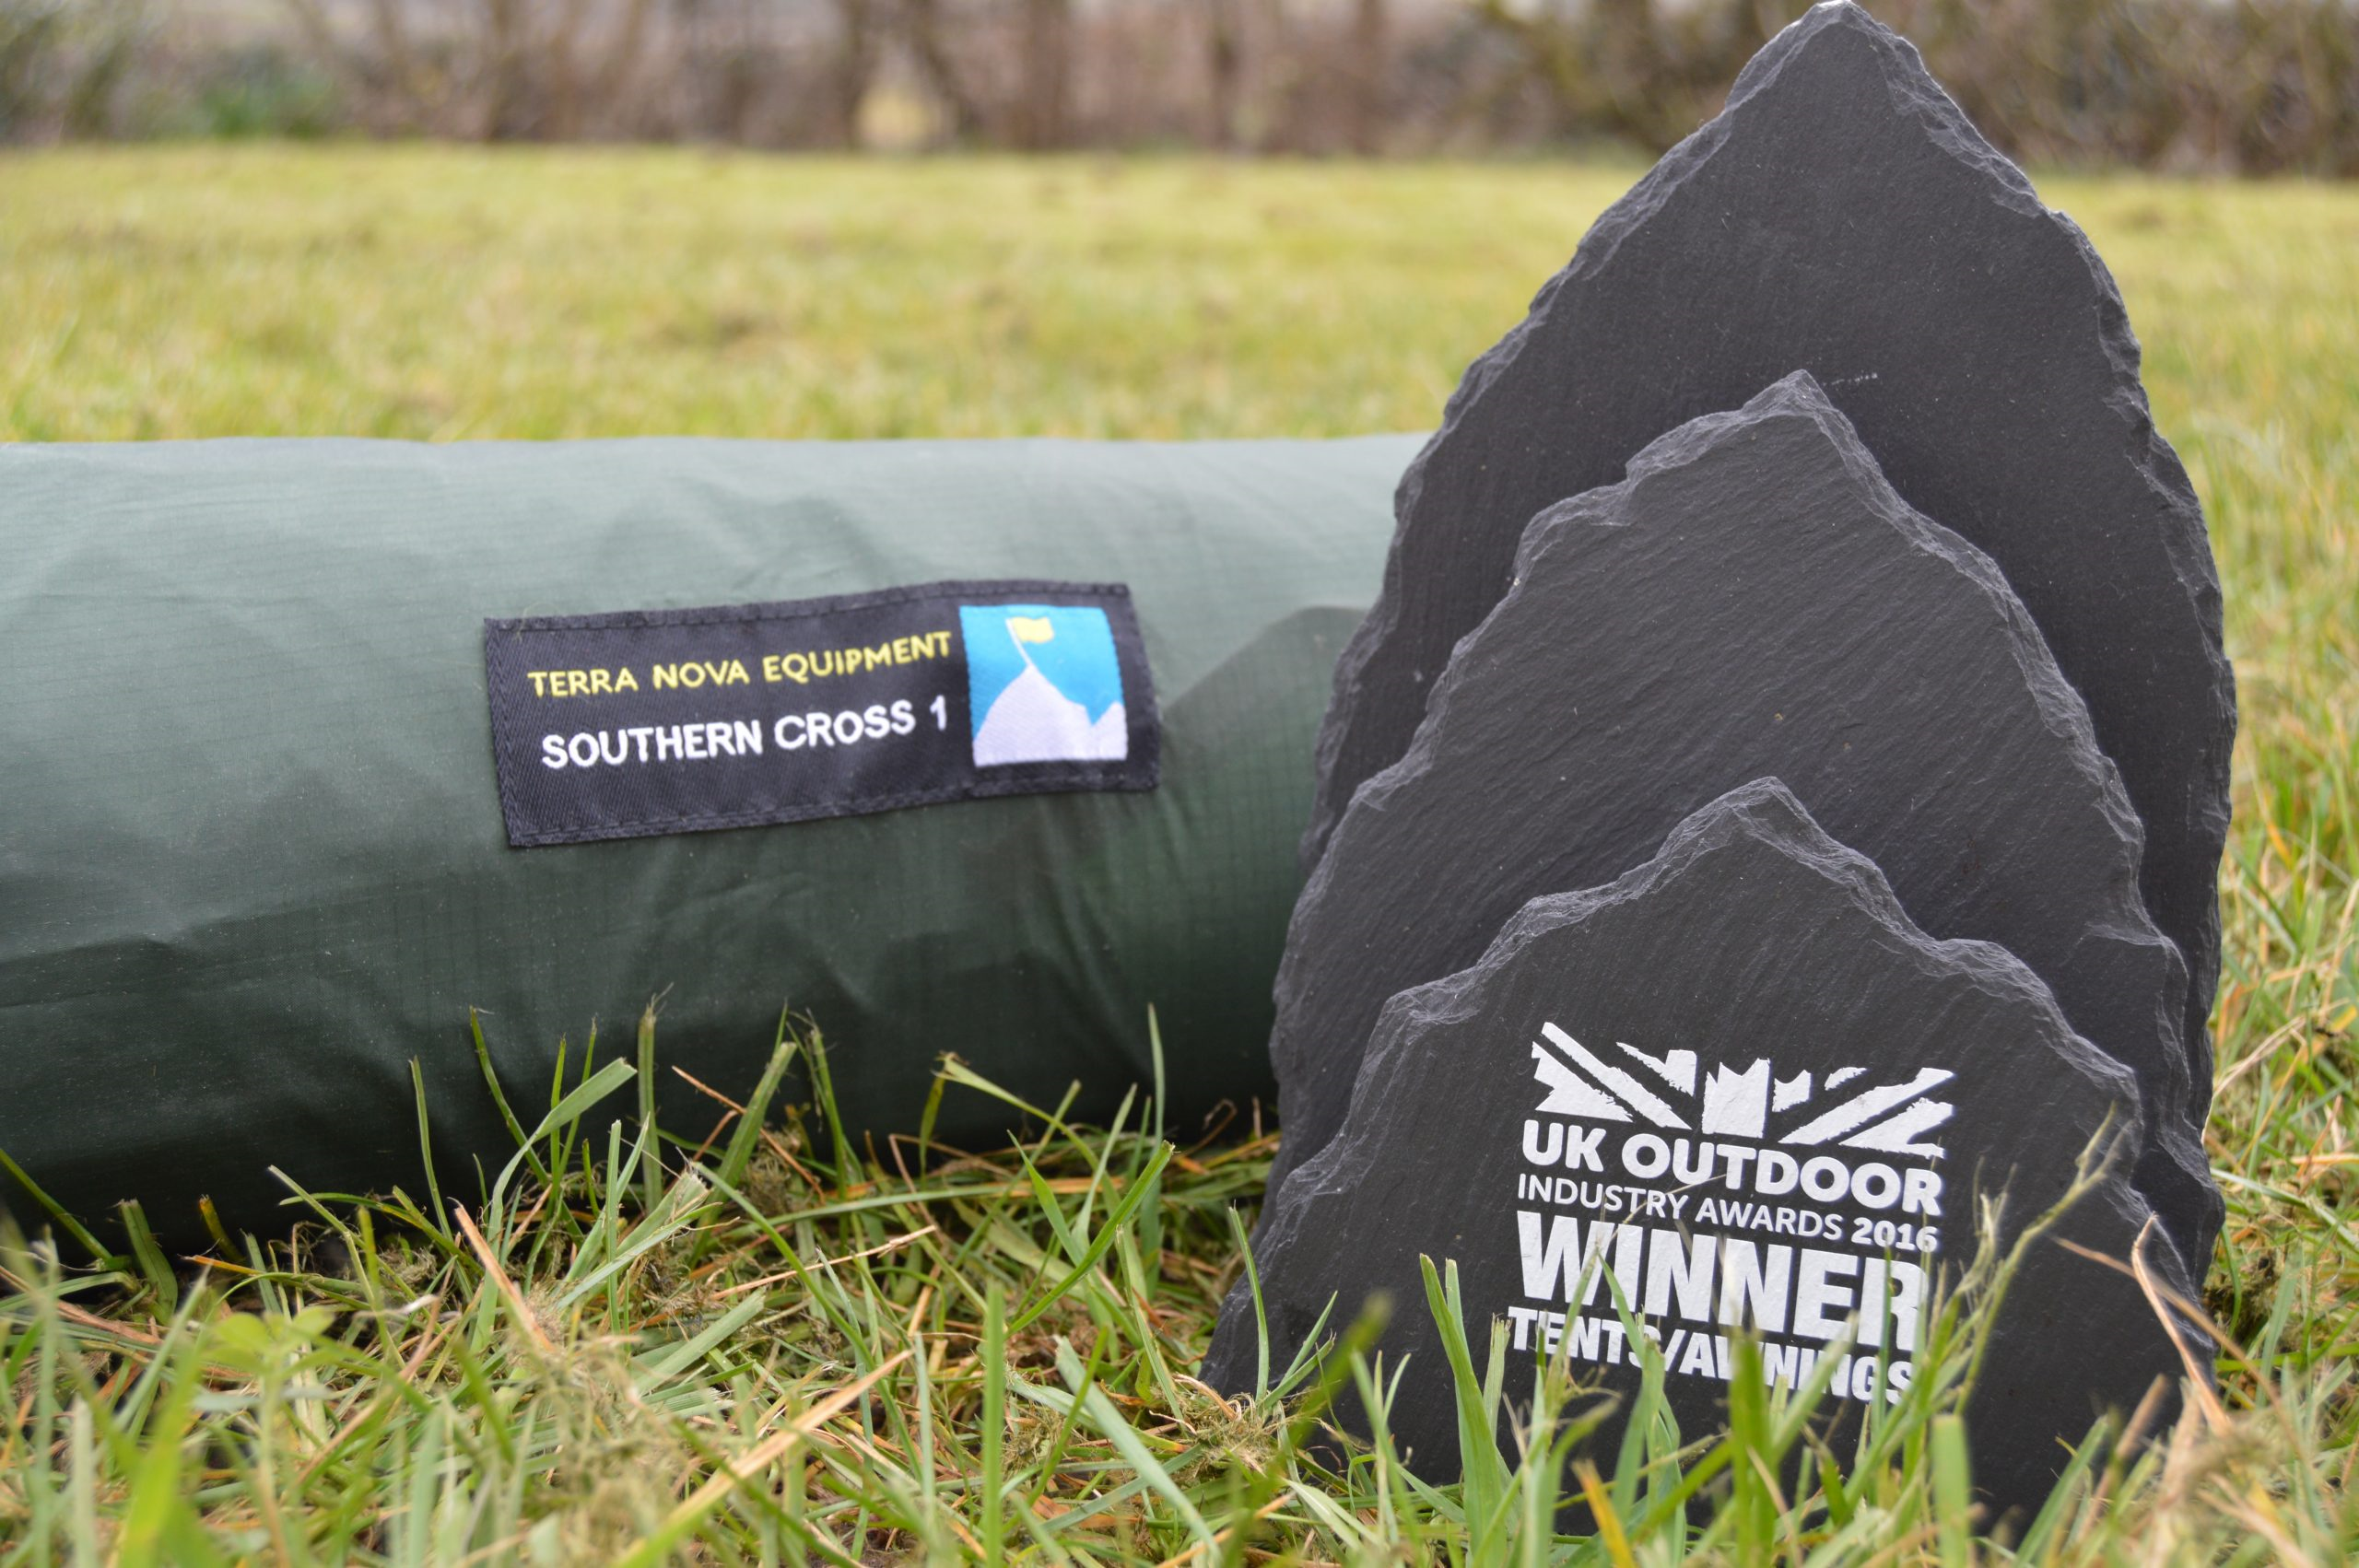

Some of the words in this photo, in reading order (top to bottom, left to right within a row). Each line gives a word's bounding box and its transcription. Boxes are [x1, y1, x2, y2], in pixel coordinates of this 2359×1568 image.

[526, 666, 640, 698] TERRA
[651, 659, 751, 691] NOVA
[761, 630, 953, 684] EQUIPMENT
[540, 720, 765, 770] SOUTHERN
[773, 698, 917, 751] CROSS
[929, 695, 948, 731] 1
[1521, 1118, 1607, 1173] UK
[1621, 1132, 1943, 1216] OUTDOOR
[1518, 1173, 1689, 1217] INDUSTRY
[1695, 1197, 1844, 1241] AWARDS
[1850, 1216, 1940, 1254] 2016
[1516, 1210, 1929, 1352] WINNER
